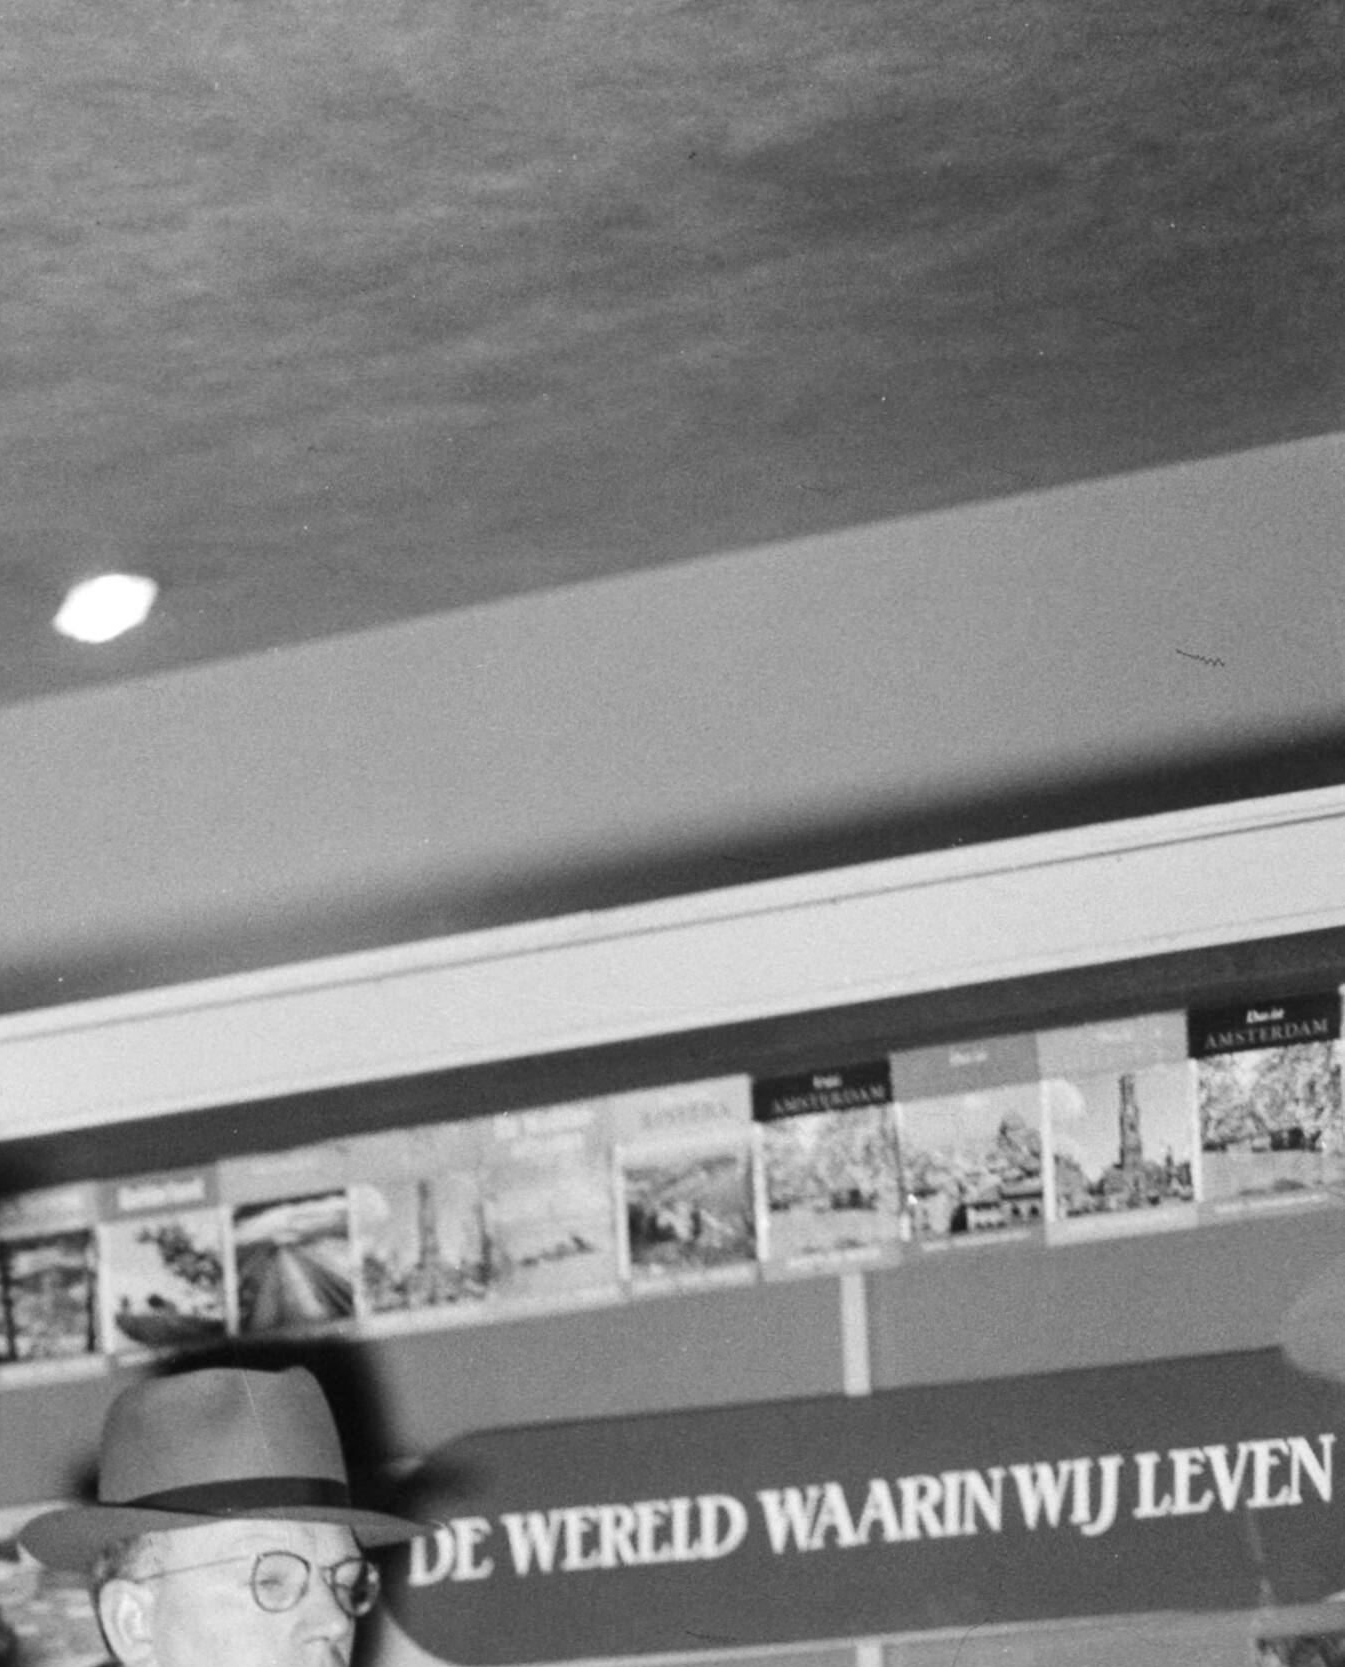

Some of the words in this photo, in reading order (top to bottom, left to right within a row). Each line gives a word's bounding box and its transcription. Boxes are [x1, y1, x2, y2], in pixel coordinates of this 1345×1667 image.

[1204, 1018, 1329, 1051] AMSTERDAM
[770, 1083, 888, 1115] AMSTERDAM
[408, 1515, 495, 1587] DE
[500, 1493, 749, 1577] WERELD
[756, 1465, 1009, 1555] WAARIN
[1009, 1454, 1124, 1537] WIJ
[1133, 1432, 1337, 1520] LEVEN
